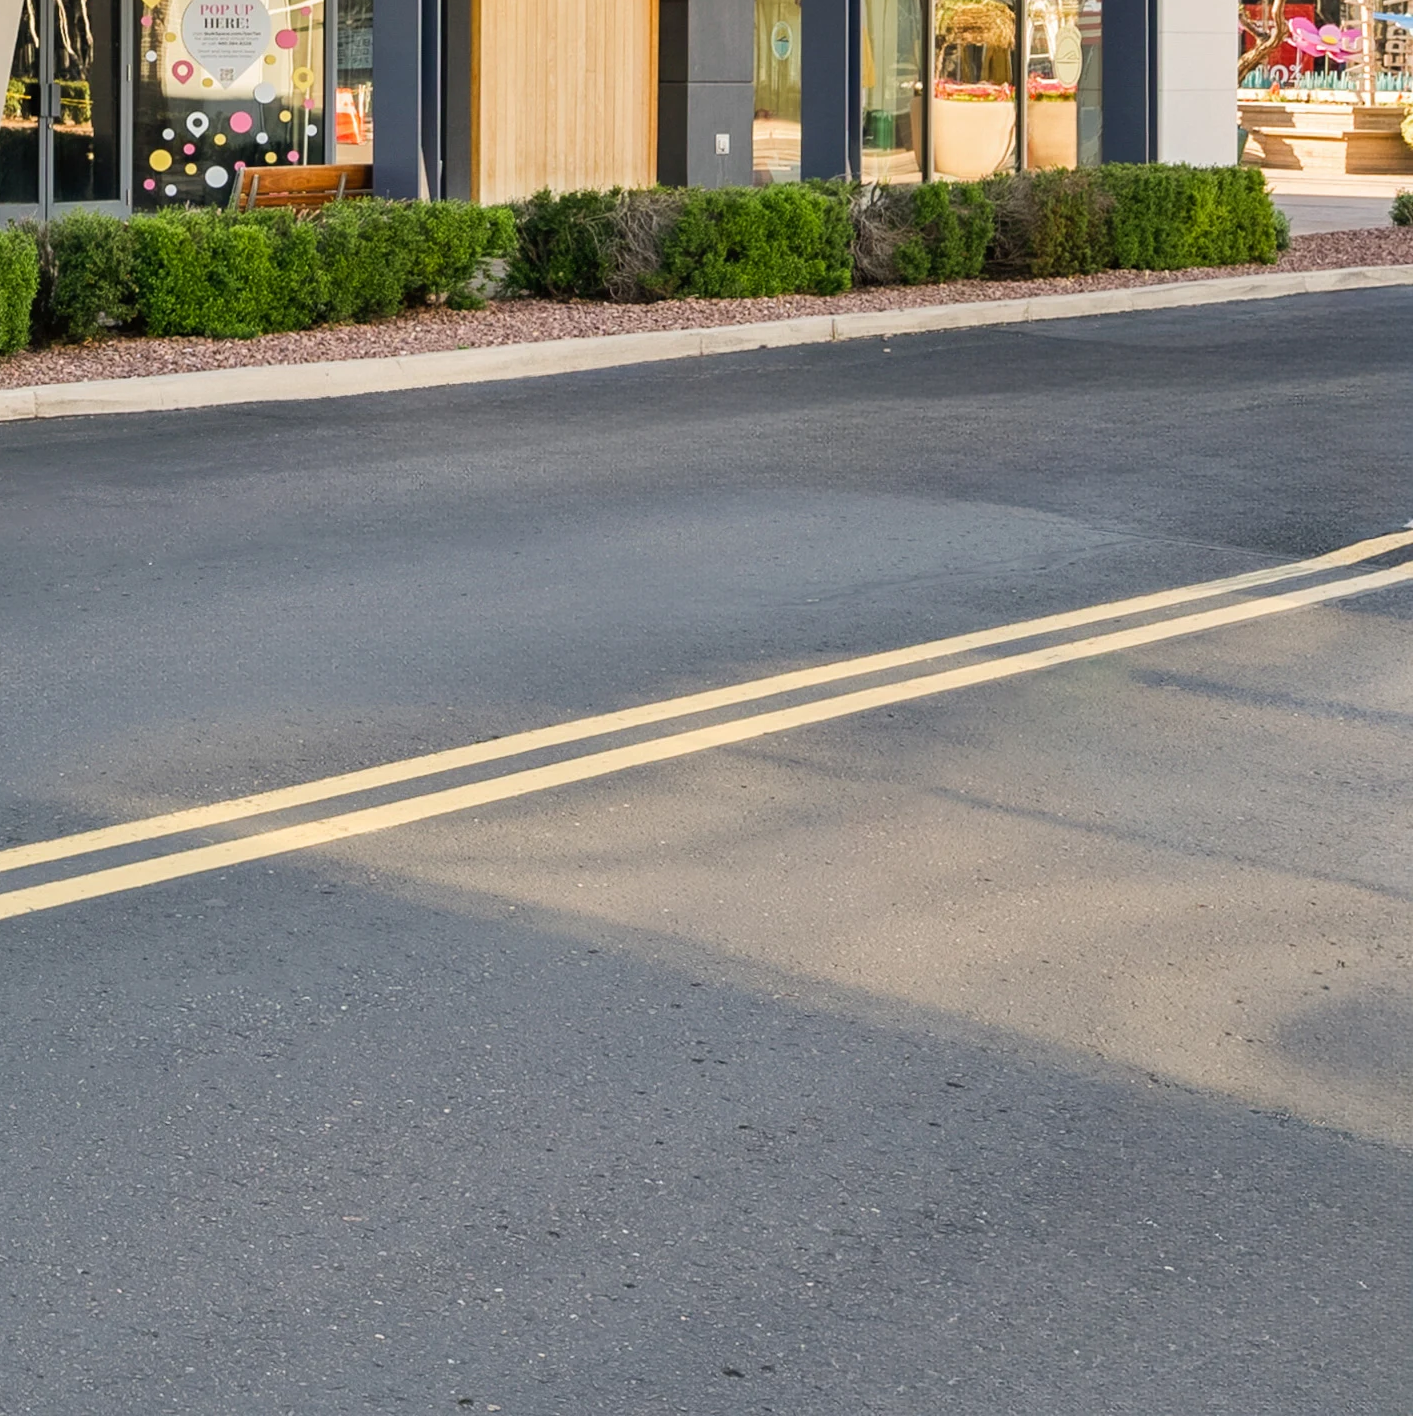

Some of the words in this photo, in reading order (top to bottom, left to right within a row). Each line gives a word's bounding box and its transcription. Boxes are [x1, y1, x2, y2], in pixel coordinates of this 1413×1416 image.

[200, 4, 230, 16] POP
[234, 4, 254, 16] UP
[204, 17, 250, 29] HERE!
